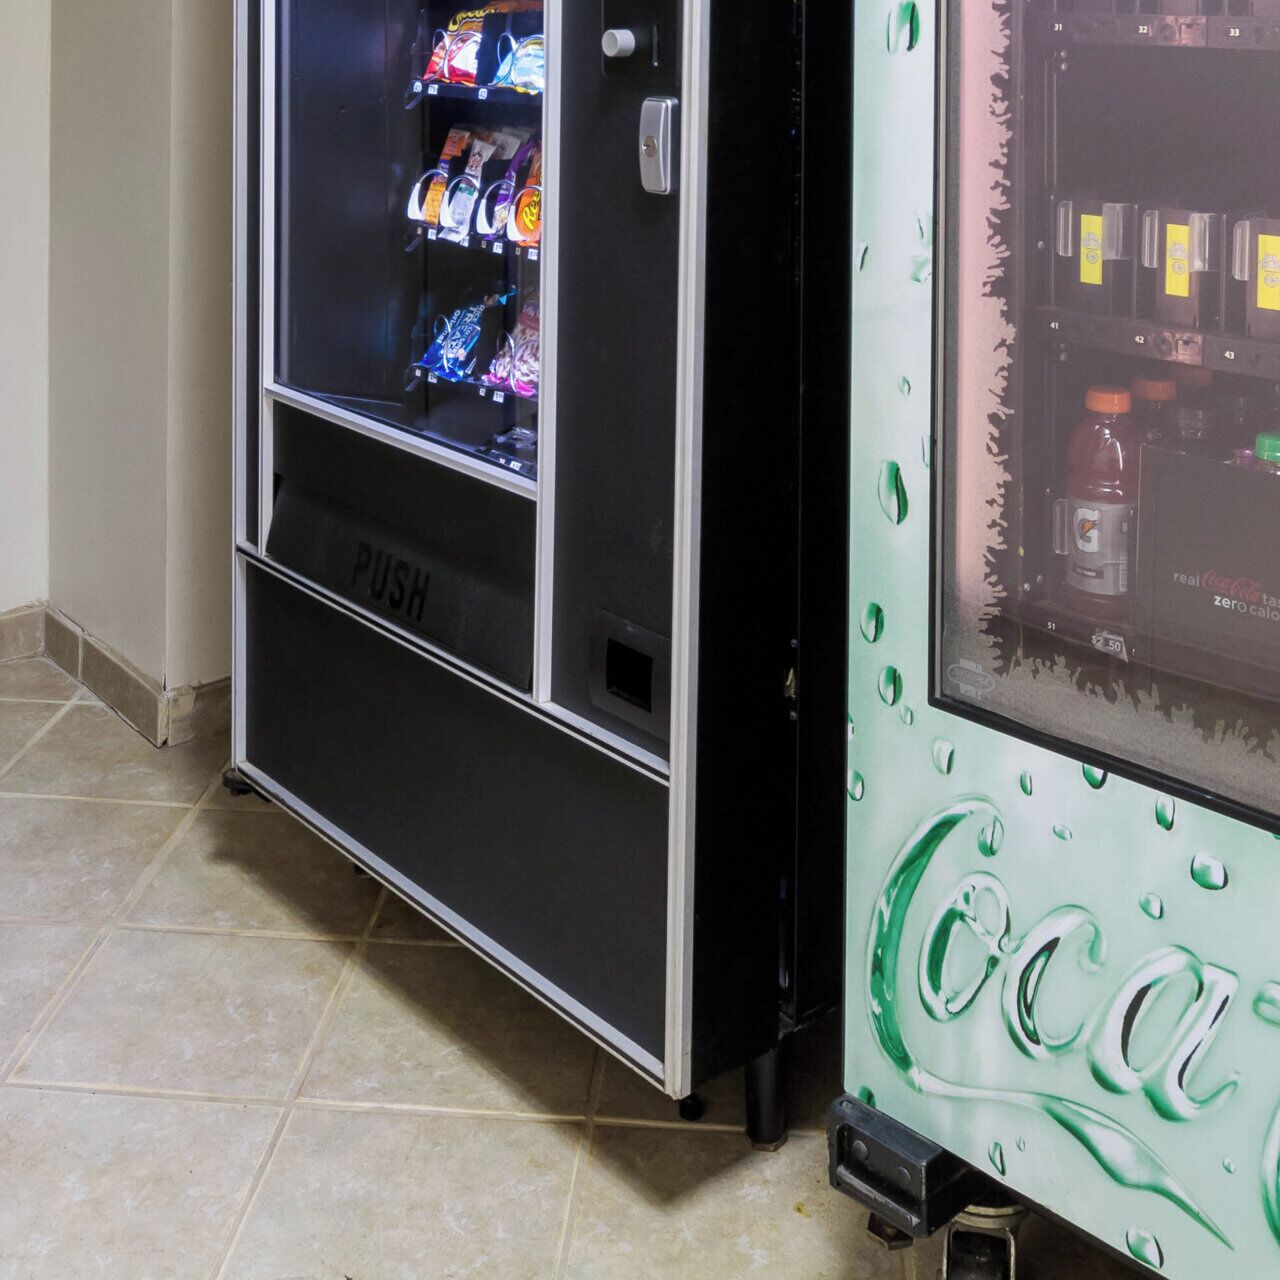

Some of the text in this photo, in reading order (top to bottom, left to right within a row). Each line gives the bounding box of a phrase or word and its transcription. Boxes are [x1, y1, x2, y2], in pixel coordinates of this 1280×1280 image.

[1138, 25, 1148, 34] 32
[1229, 28, 1240, 37] 33
[1134, 335, 1145, 344] 42
[1224, 350, 1235, 360] 43
[351, 540, 431, 623] PUSH
[1173, 570, 1201, 589] real
[1200, 568, 1263, 604] Coca-Cola
[1214, 594, 1248, 614] zero
